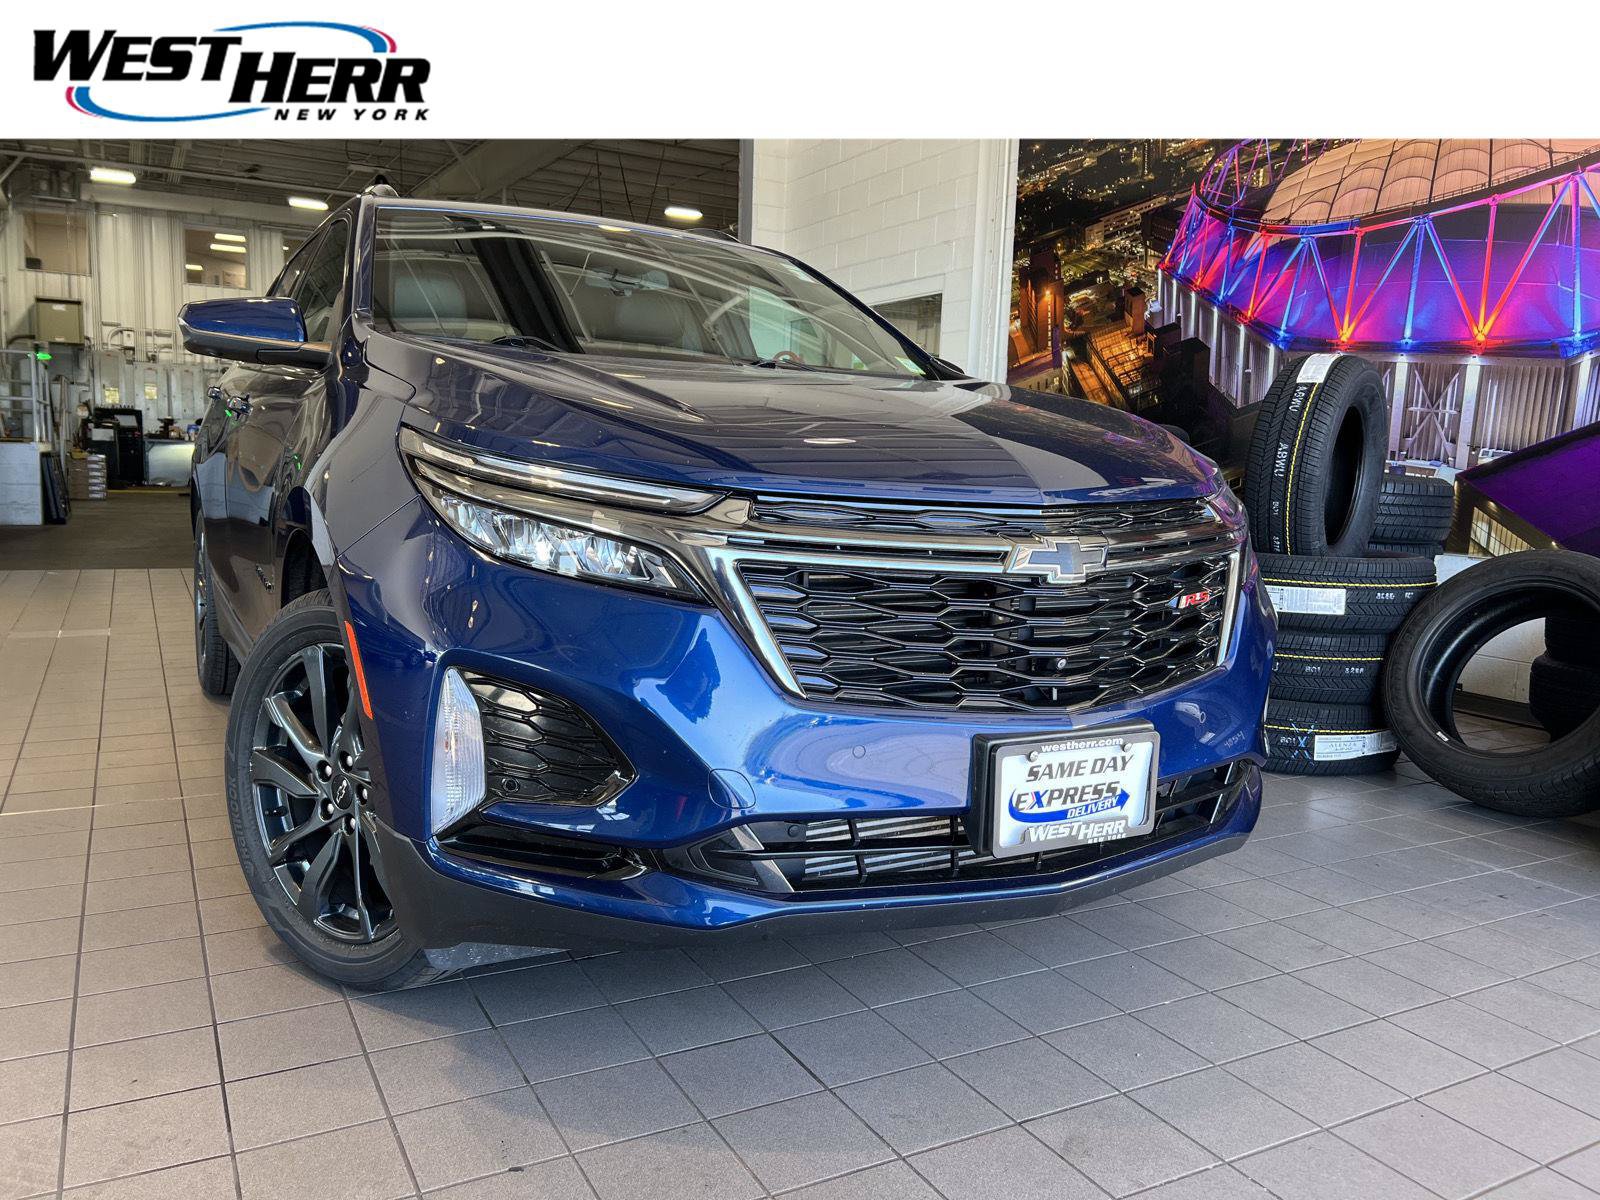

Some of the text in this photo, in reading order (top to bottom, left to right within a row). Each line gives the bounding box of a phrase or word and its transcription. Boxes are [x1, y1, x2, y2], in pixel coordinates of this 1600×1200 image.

[1184, 591, 1210, 607] RS
[1041, 737, 1124, 753] westherr.com
[1026, 755, 1134, 782] SAME DAY
[1014, 780, 1120, 811] EXPRESS
[1067, 796, 1119, 819] DELIVERY
